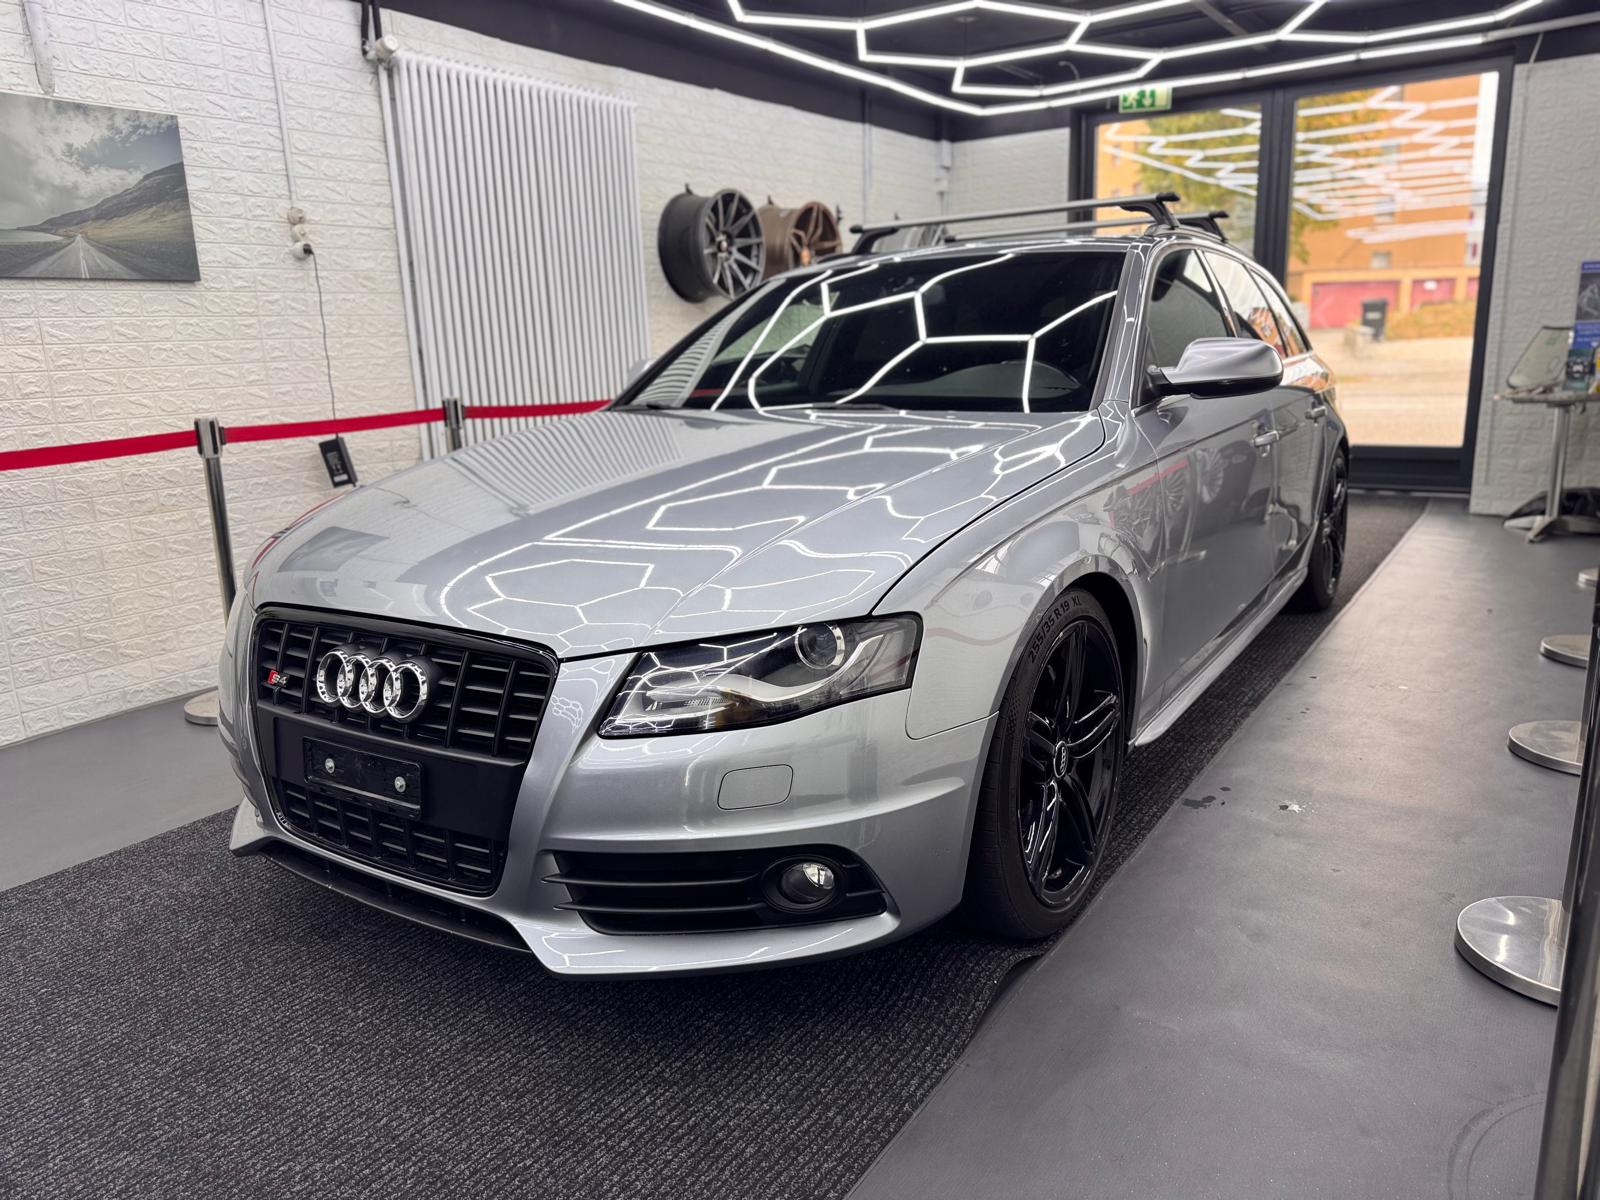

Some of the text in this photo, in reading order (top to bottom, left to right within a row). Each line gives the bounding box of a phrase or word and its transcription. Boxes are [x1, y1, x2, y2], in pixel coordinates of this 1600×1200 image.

[1028, 595, 1082, 663] 255/35 R 19 XL
[269, 672, 288, 687] S4
